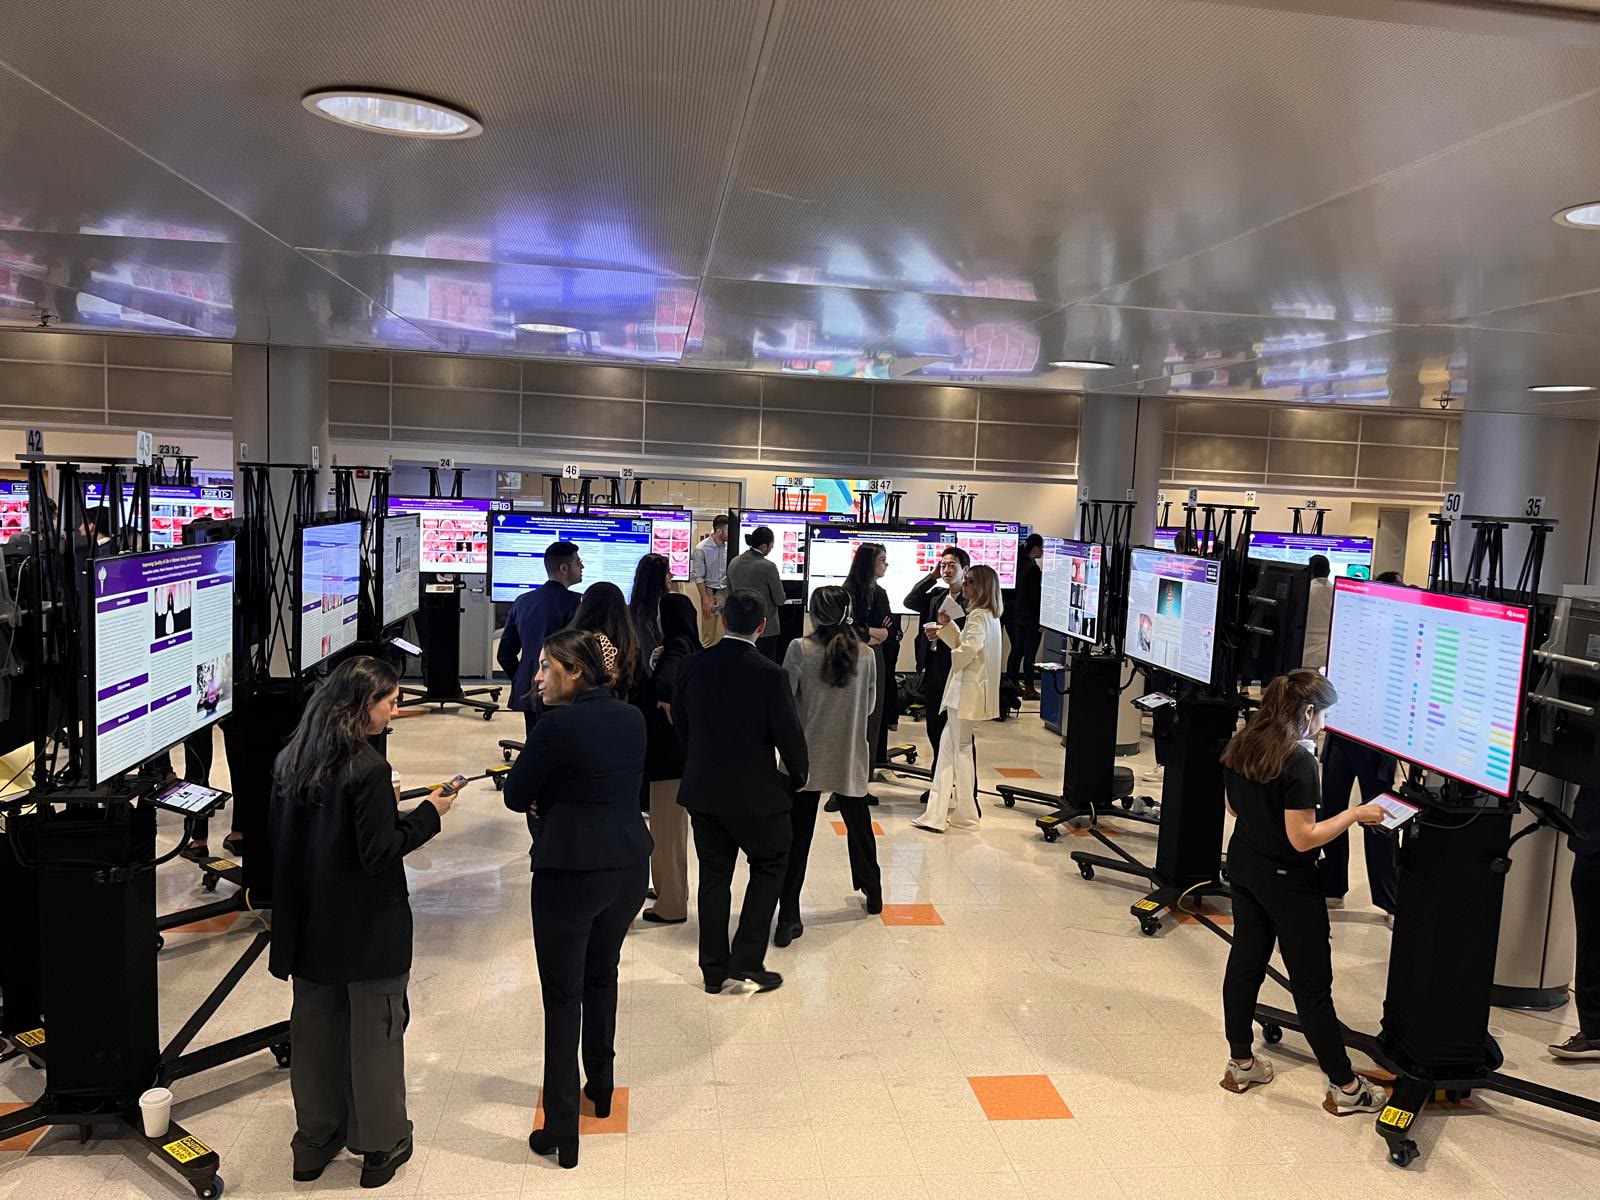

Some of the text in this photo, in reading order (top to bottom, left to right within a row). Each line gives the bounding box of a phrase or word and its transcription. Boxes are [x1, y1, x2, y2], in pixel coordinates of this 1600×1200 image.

[28, 430, 42, 452] 42
[139, 434, 150, 457] 43
[159, 445, 170, 454] 23
[171, 446, 181, 455] 12
[440, 459, 450, 467] 24
[565, 465, 577, 475] 46
[623, 468, 633, 477] 25
[794, 477, 803, 485] 26
[880, 480, 891, 490] 47
[958, 484, 967, 492] 27
[1307, 500, 1317, 508] 29
[1446, 493, 1461, 512] 50
[1526, 498, 1541, 516] 35
